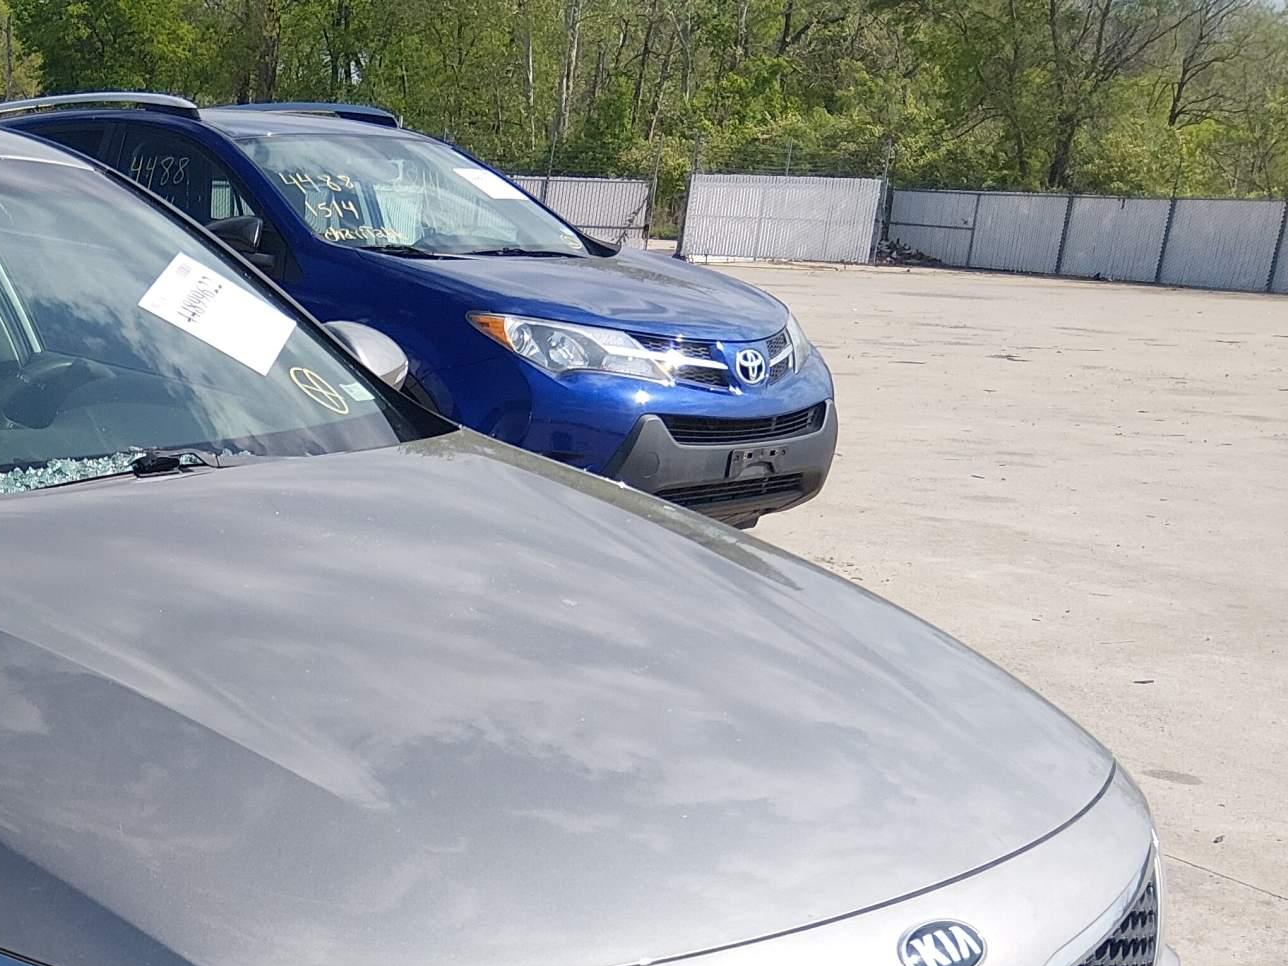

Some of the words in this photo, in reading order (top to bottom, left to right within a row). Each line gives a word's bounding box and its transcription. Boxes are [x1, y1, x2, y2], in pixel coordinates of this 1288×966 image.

[127, 155, 191, 191] 4488
[278, 171, 355, 194] 4488
[304, 198, 360, 220] 1514
